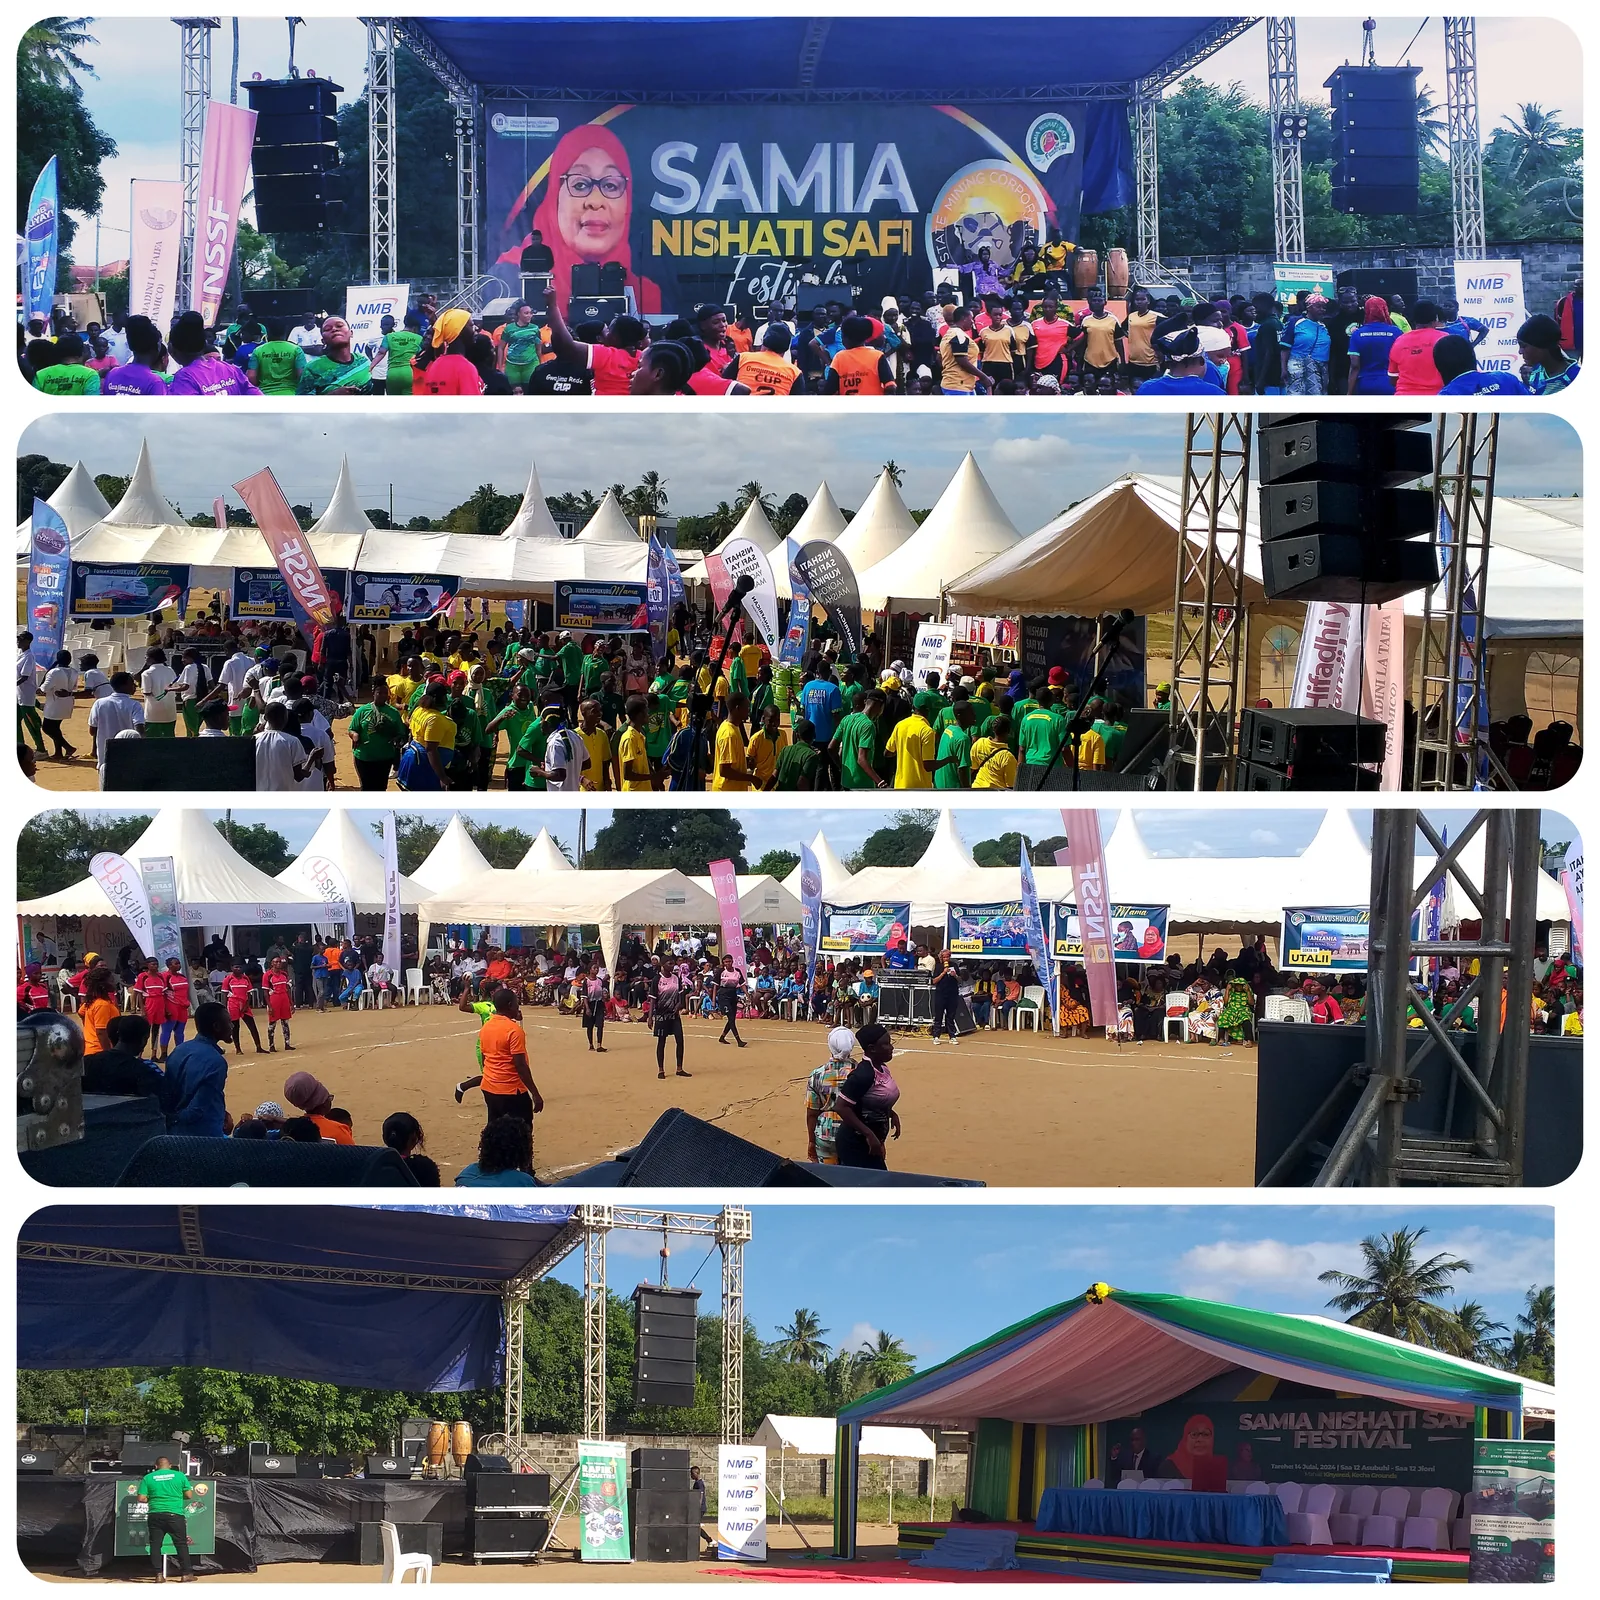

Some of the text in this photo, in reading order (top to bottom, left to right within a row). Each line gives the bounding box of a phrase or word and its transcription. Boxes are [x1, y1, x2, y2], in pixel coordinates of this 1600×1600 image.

[650, 140, 919, 214] SAMIA
[934, 172, 985, 263] STATE MINING
[652, 219, 913, 257] NISHATI SAFI
[203, 196, 230, 296] NSSF
[141, 240, 163, 317] MADINI LA TAIFA
[1466, 278, 1504, 290] NMB
[151, 283, 165, 328] TAMICO)
[1494, 296, 1514, 304] NMB
[356, 303, 392, 315] NMB
[1480, 317, 1507, 329] MB
[1477, 359, 1511, 371] NMB
[754, 374, 782, 385] CUP
[843, 378, 862, 388] CUP
[553, 382, 571, 392] CUP
[356, 608, 387, 616] AFYA
[562, 618, 591, 626] UTALII
[921, 637, 942, 648] NMB
[1304, 619, 1342, 708] Hifadhi
[1374, 614, 1392, 724] ADINI LA TAIFA
[1386, 682, 1398, 756] (STAMICO)
[868, 903, 893, 916] Mama
[1002, 903, 1024, 917] Ma
[1114, 905, 1147, 918] Mama
[1310, 914, 1358, 923] TUNAKUSHUKURU
[1291, 954, 1329, 963] UTALII
[1239, 1410, 1474, 1431] SAMIA NISHATI SAF
[1293, 1430, 1412, 1449] FESTIVAL
[726, 1459, 753, 1469] NMB
[726, 1489, 753, 1499] NMB
[726, 1521, 753, 1531] NMB
